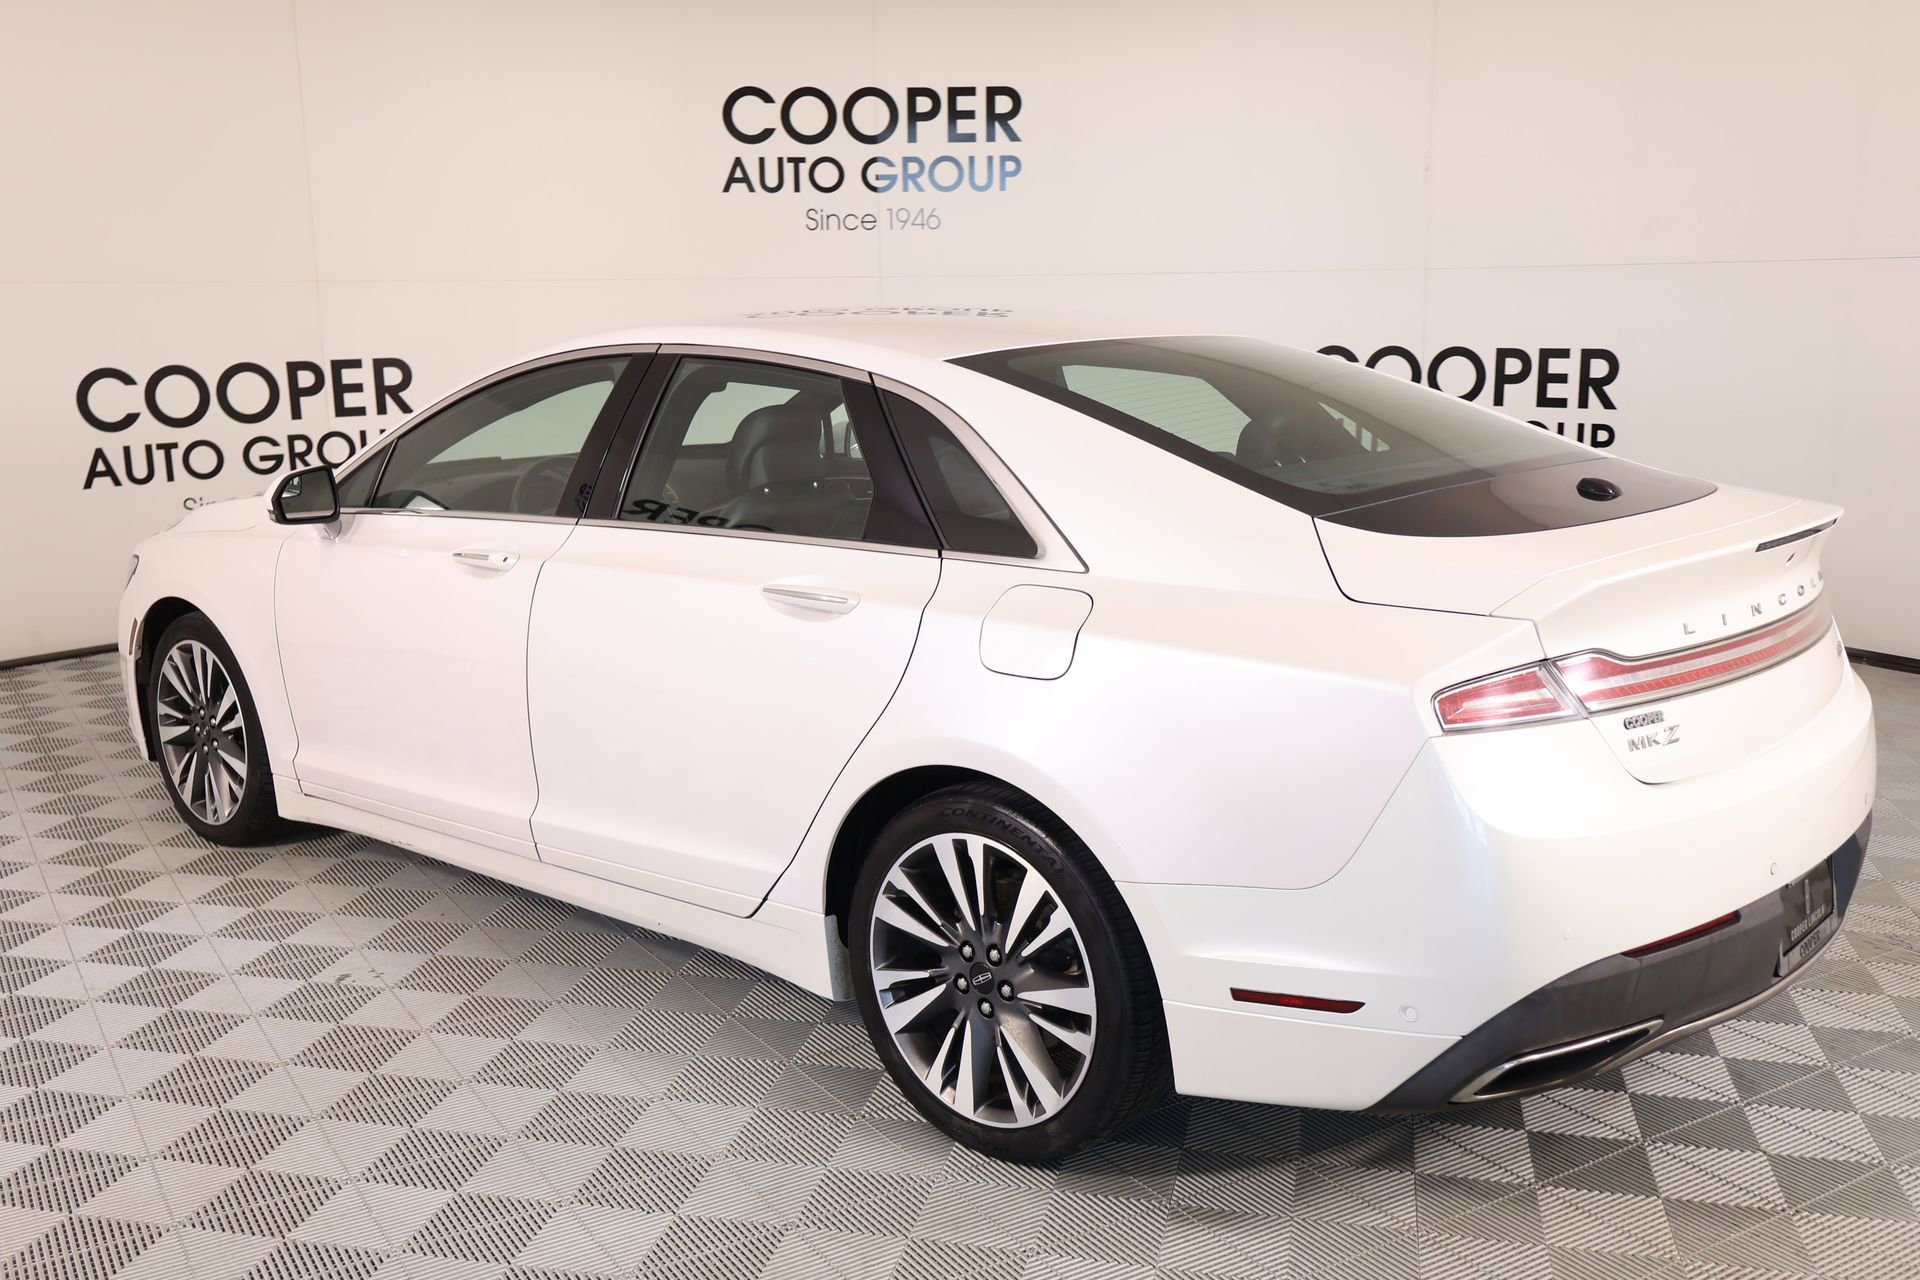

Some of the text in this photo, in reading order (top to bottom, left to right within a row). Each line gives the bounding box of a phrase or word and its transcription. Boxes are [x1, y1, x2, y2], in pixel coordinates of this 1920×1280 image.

[722, 86, 1022, 145] COOPER
[722, 155, 1022, 193] AUTO GROUP
[806, 208, 941, 231] Since 1946
[76, 357, 414, 433] COOPER
[83, 429, 386, 490] AUTO GRO
[1623, 710, 1664, 730] COOPER
[1627, 724, 1680, 752] MKZ
[942, 807, 1065, 876] CONTINENTAL
